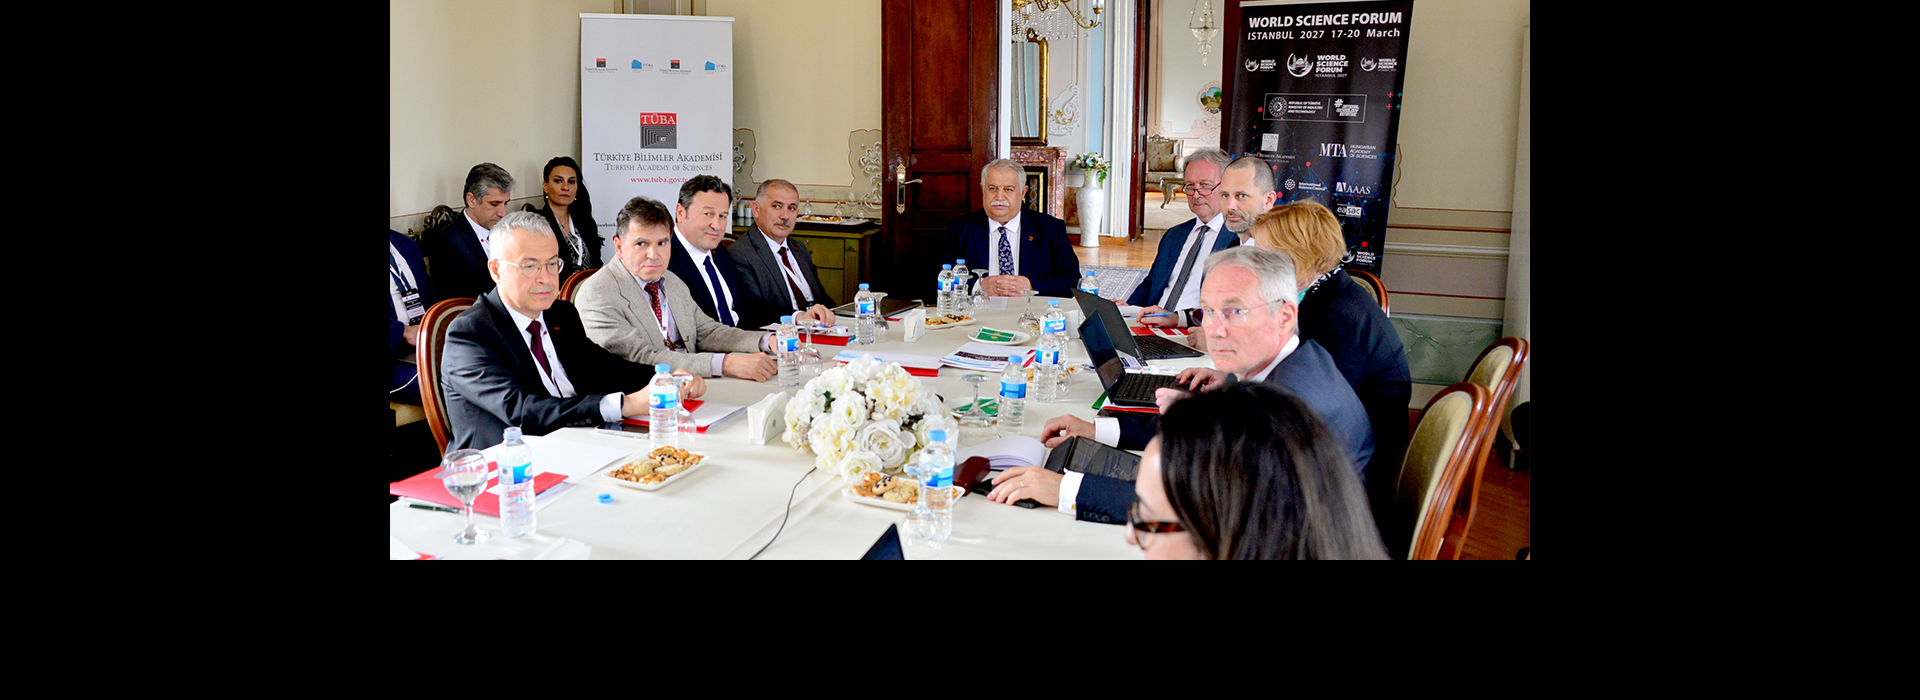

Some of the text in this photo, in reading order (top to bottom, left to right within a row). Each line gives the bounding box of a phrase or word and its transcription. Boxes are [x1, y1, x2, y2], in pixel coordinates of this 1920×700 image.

[1248, 12, 1403, 28] WORLD SCIENCE FORUM
[1247, 27, 1401, 41] ISTANBUL 2027 17-20 March
[640, 113, 676, 125] TÜBA
[1318, 143, 1348, 158] MTA
[593, 152, 723, 162] TÜRKİYE BİLİMLER AKADEMİSİ
[604, 163, 713, 172] TURKISH ACADEMY OF SCIENCES
[630, 176, 688, 185] www.tuba.gov.tr
[1346, 185, 1371, 195] AAAS
